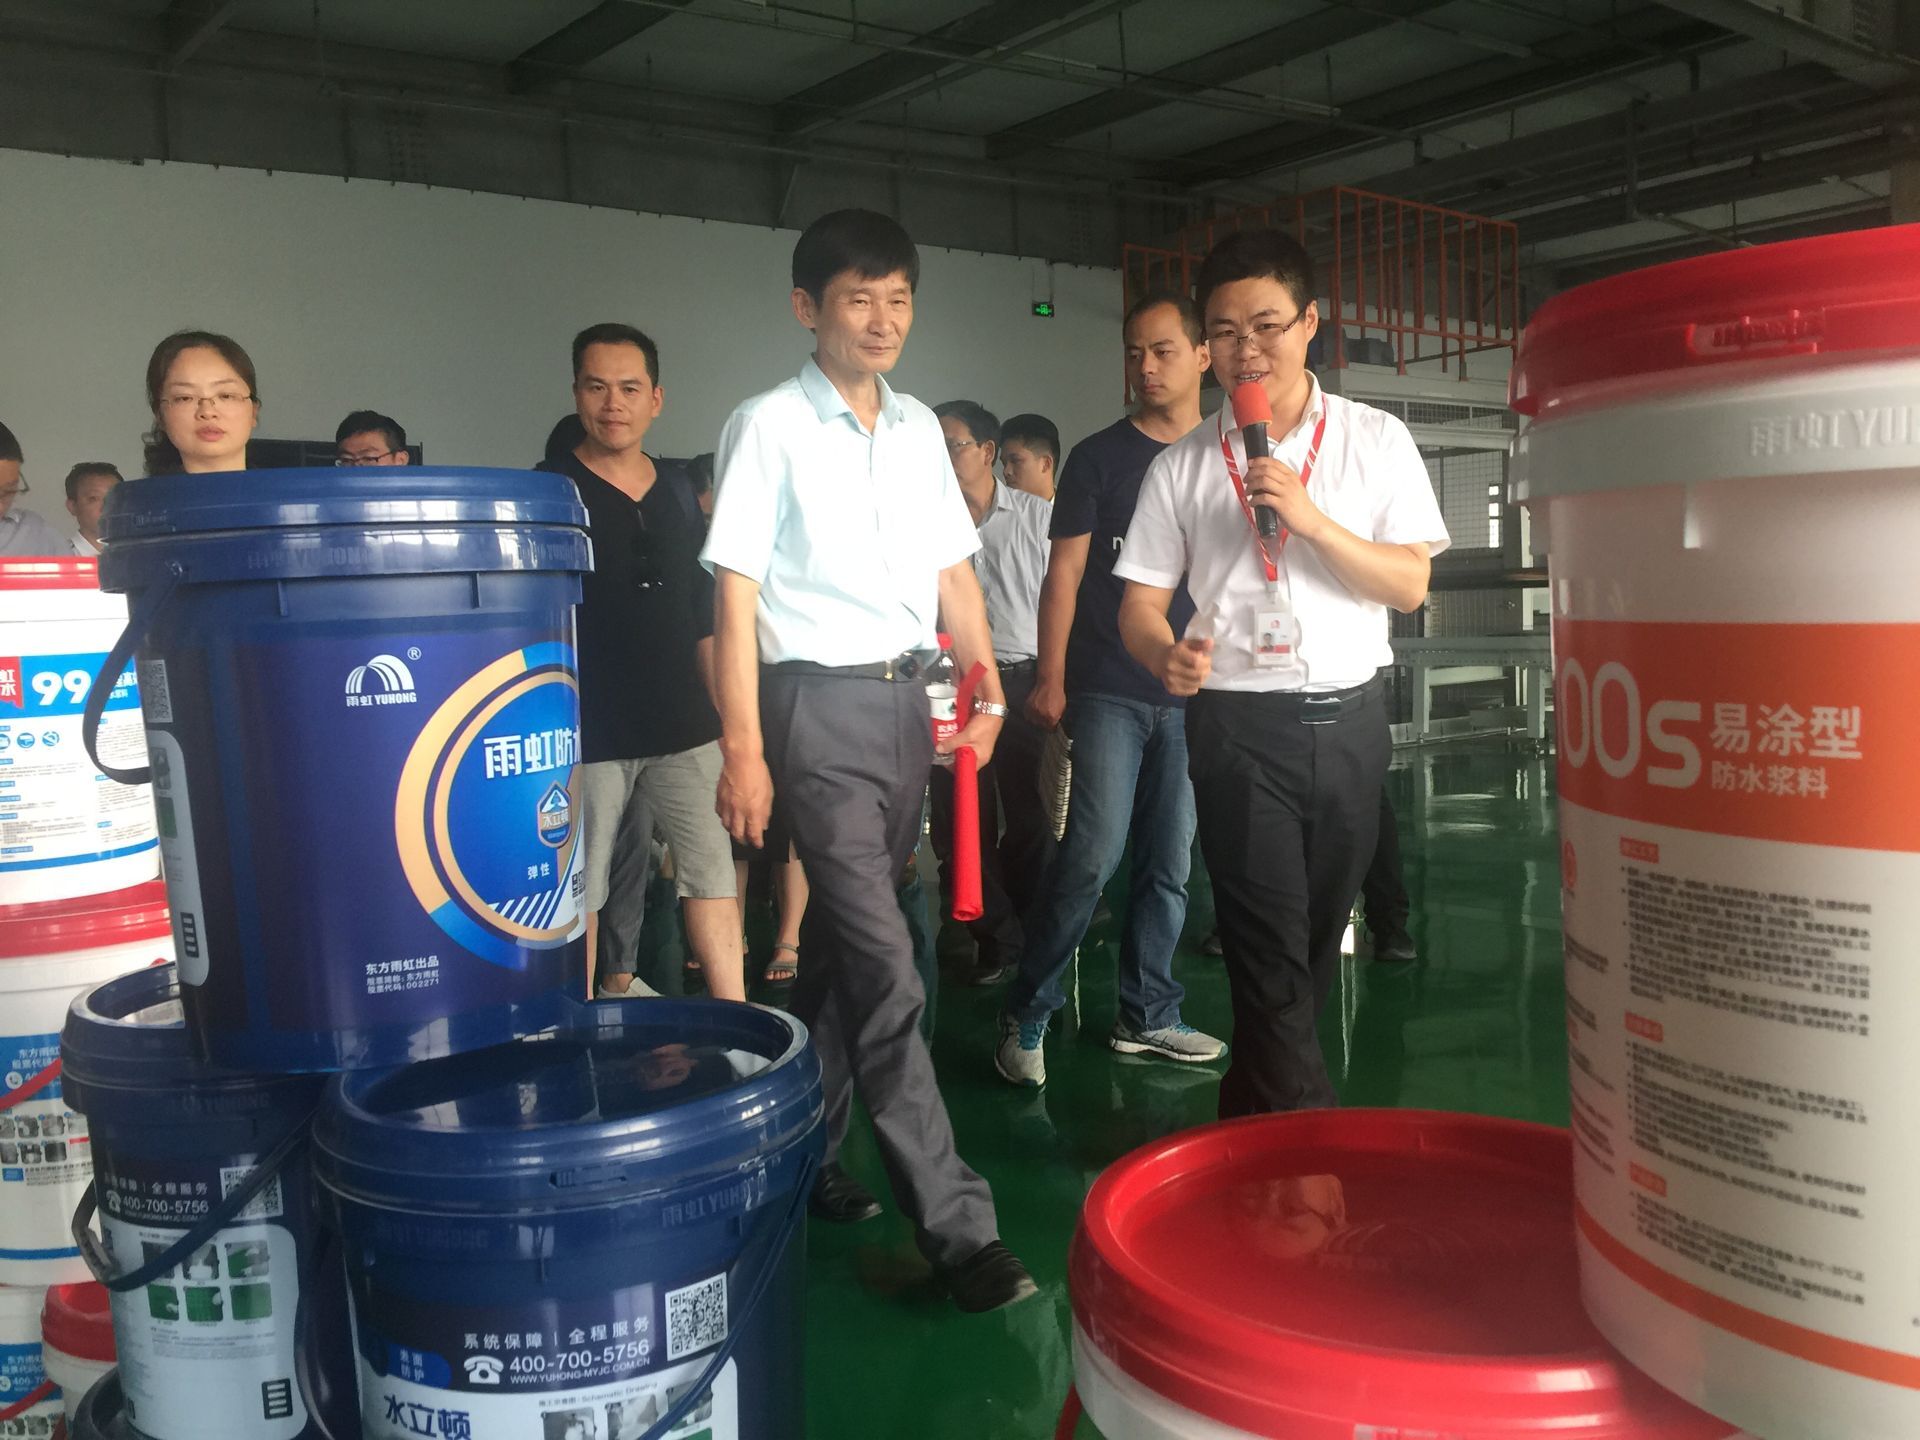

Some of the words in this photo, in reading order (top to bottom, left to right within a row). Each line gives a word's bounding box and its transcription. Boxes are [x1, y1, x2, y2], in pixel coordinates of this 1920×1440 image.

[1750, 410, 1847, 457] 雨虹
[32, 669, 92, 706] 99
[346, 694, 373, 707] 雨虹
[374, 692, 417, 705] YUHONG
[1710, 702, 1863, 760] 易涂型
[1711, 760, 1829, 799] 防水浆料
[526, 861, 550, 881] 弹性
[366, 955, 439, 976] 东方雨虹出品
[123, 1195, 210, 1214] 400-700-5756
[463, 1332, 543, 1351] 系统保障
[568, 1316, 650, 1346] 全程服务
[509, 1338, 650, 1374] 400-700-5756
[510, 1357, 651, 1385] WWW.YUHONG-MYJC.COM.CN
[383, 1393, 472, 1440] 水立顿
